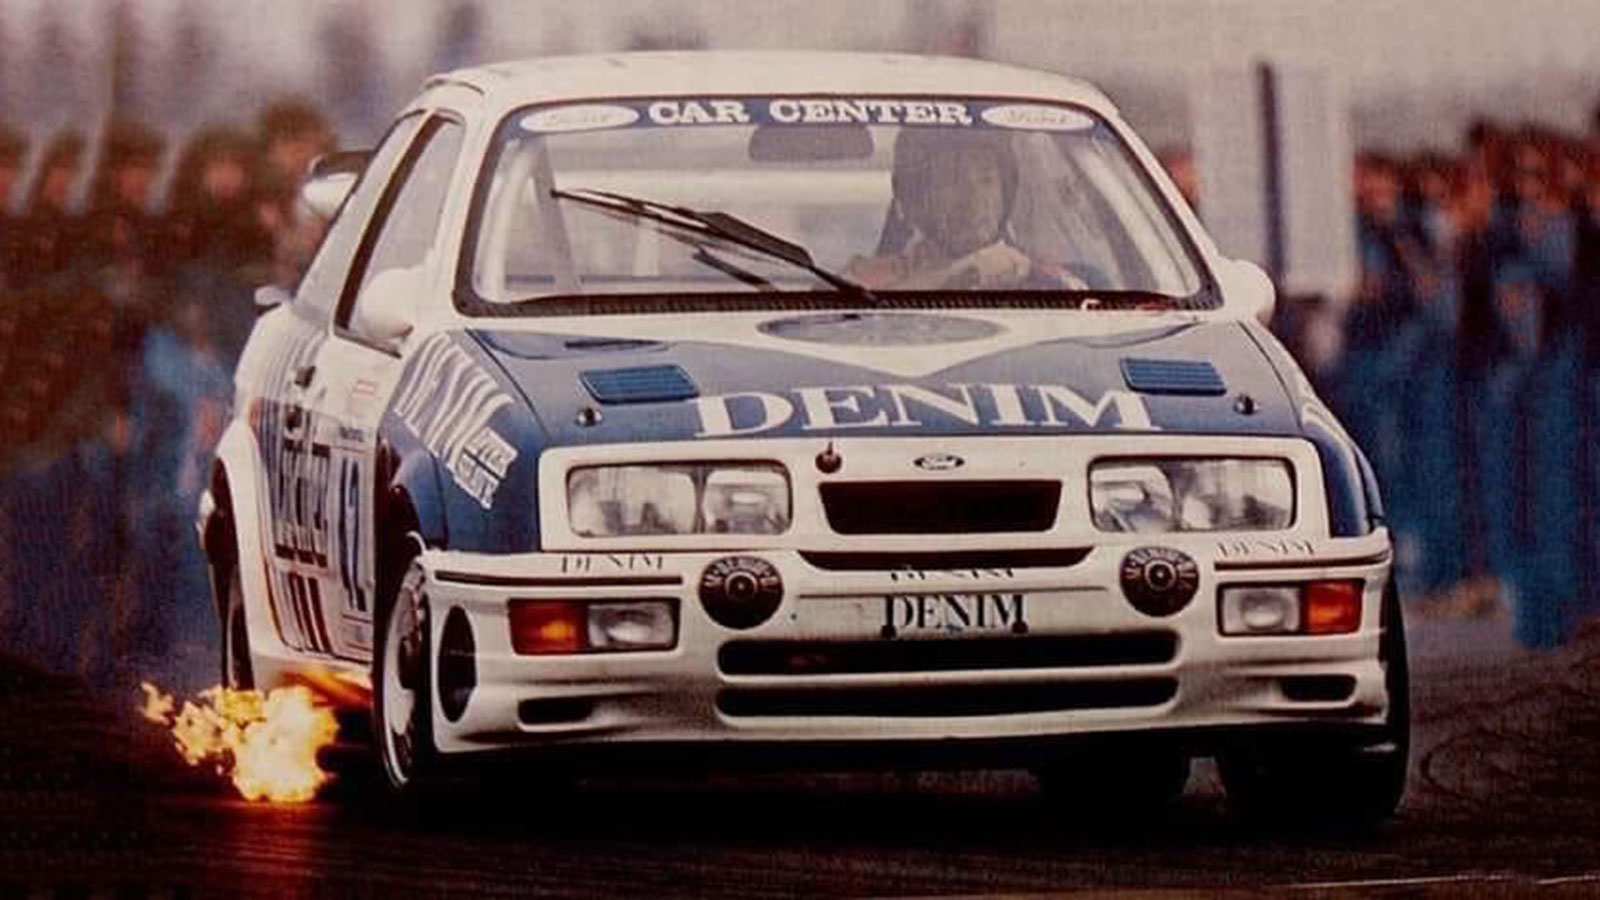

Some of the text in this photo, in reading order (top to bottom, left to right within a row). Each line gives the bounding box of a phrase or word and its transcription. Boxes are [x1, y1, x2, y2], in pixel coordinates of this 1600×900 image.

[648, 100, 973, 126] CAR CENTER
[694, 383, 1162, 437] DENIM
[883, 594, 1027, 630] DENIM
